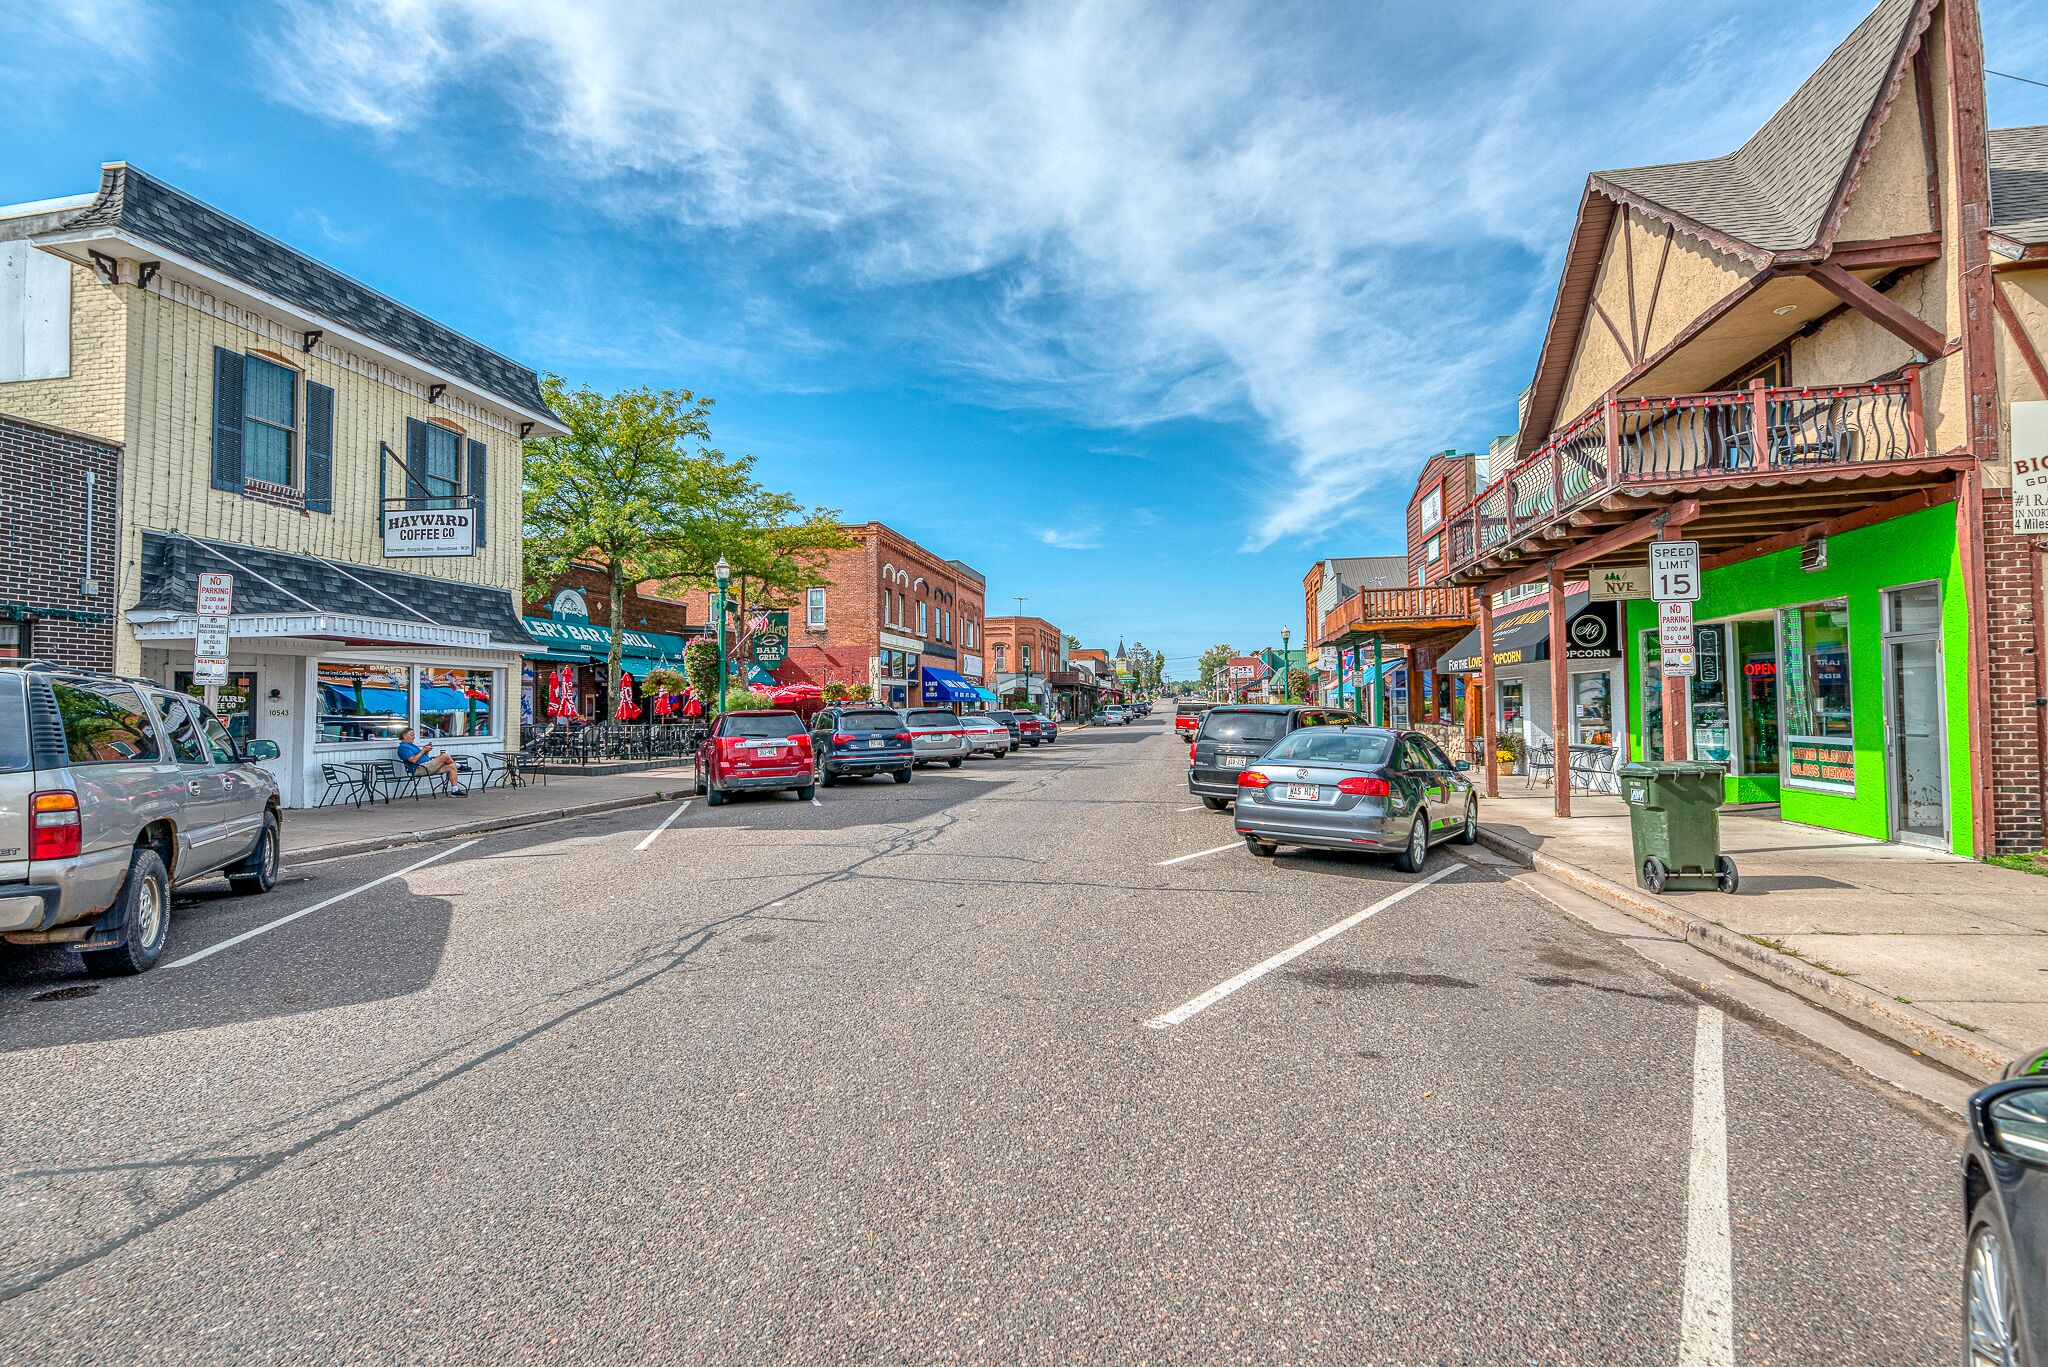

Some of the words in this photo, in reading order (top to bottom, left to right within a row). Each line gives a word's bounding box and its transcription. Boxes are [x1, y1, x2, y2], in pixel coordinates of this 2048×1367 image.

[2015, 494, 2030, 506] #1
[2015, 510, 2024, 518] IN
[388, 514, 469, 530] HAYWARD
[2015, 519, 2020, 529] 4
[2025, 519, 2048, 529] Miles
[400, 529, 440, 540] COFFEE
[443, 528, 455, 537] CO
[1654, 548, 1694, 557] SPEED
[1659, 561, 1689, 569] LIMIT
[210, 577, 221, 585] NO
[1660, 574, 1691, 595] 15
[202, 587, 229, 595] PARKING
[1605, 582, 1638, 594] NVE
[1670, 606, 1681, 614] NO
[566, 625, 604, 642] BAR
[1565, 649, 1610, 657] OPCORN
[1701, 632, 1716, 680] CIGARS
[1449, 660, 1458, 671] FOR
[1459, 659, 1468, 669] THE
[1468, 657, 1482, 668] LOVE
[1744, 663, 1776, 676] OPEN
[1792, 747, 1816, 760] HAND
[1819, 749, 1853, 764] BLOWN
[1791, 763, 1820, 777] GLASS
[1822, 765, 1854, 781] DEMOS
